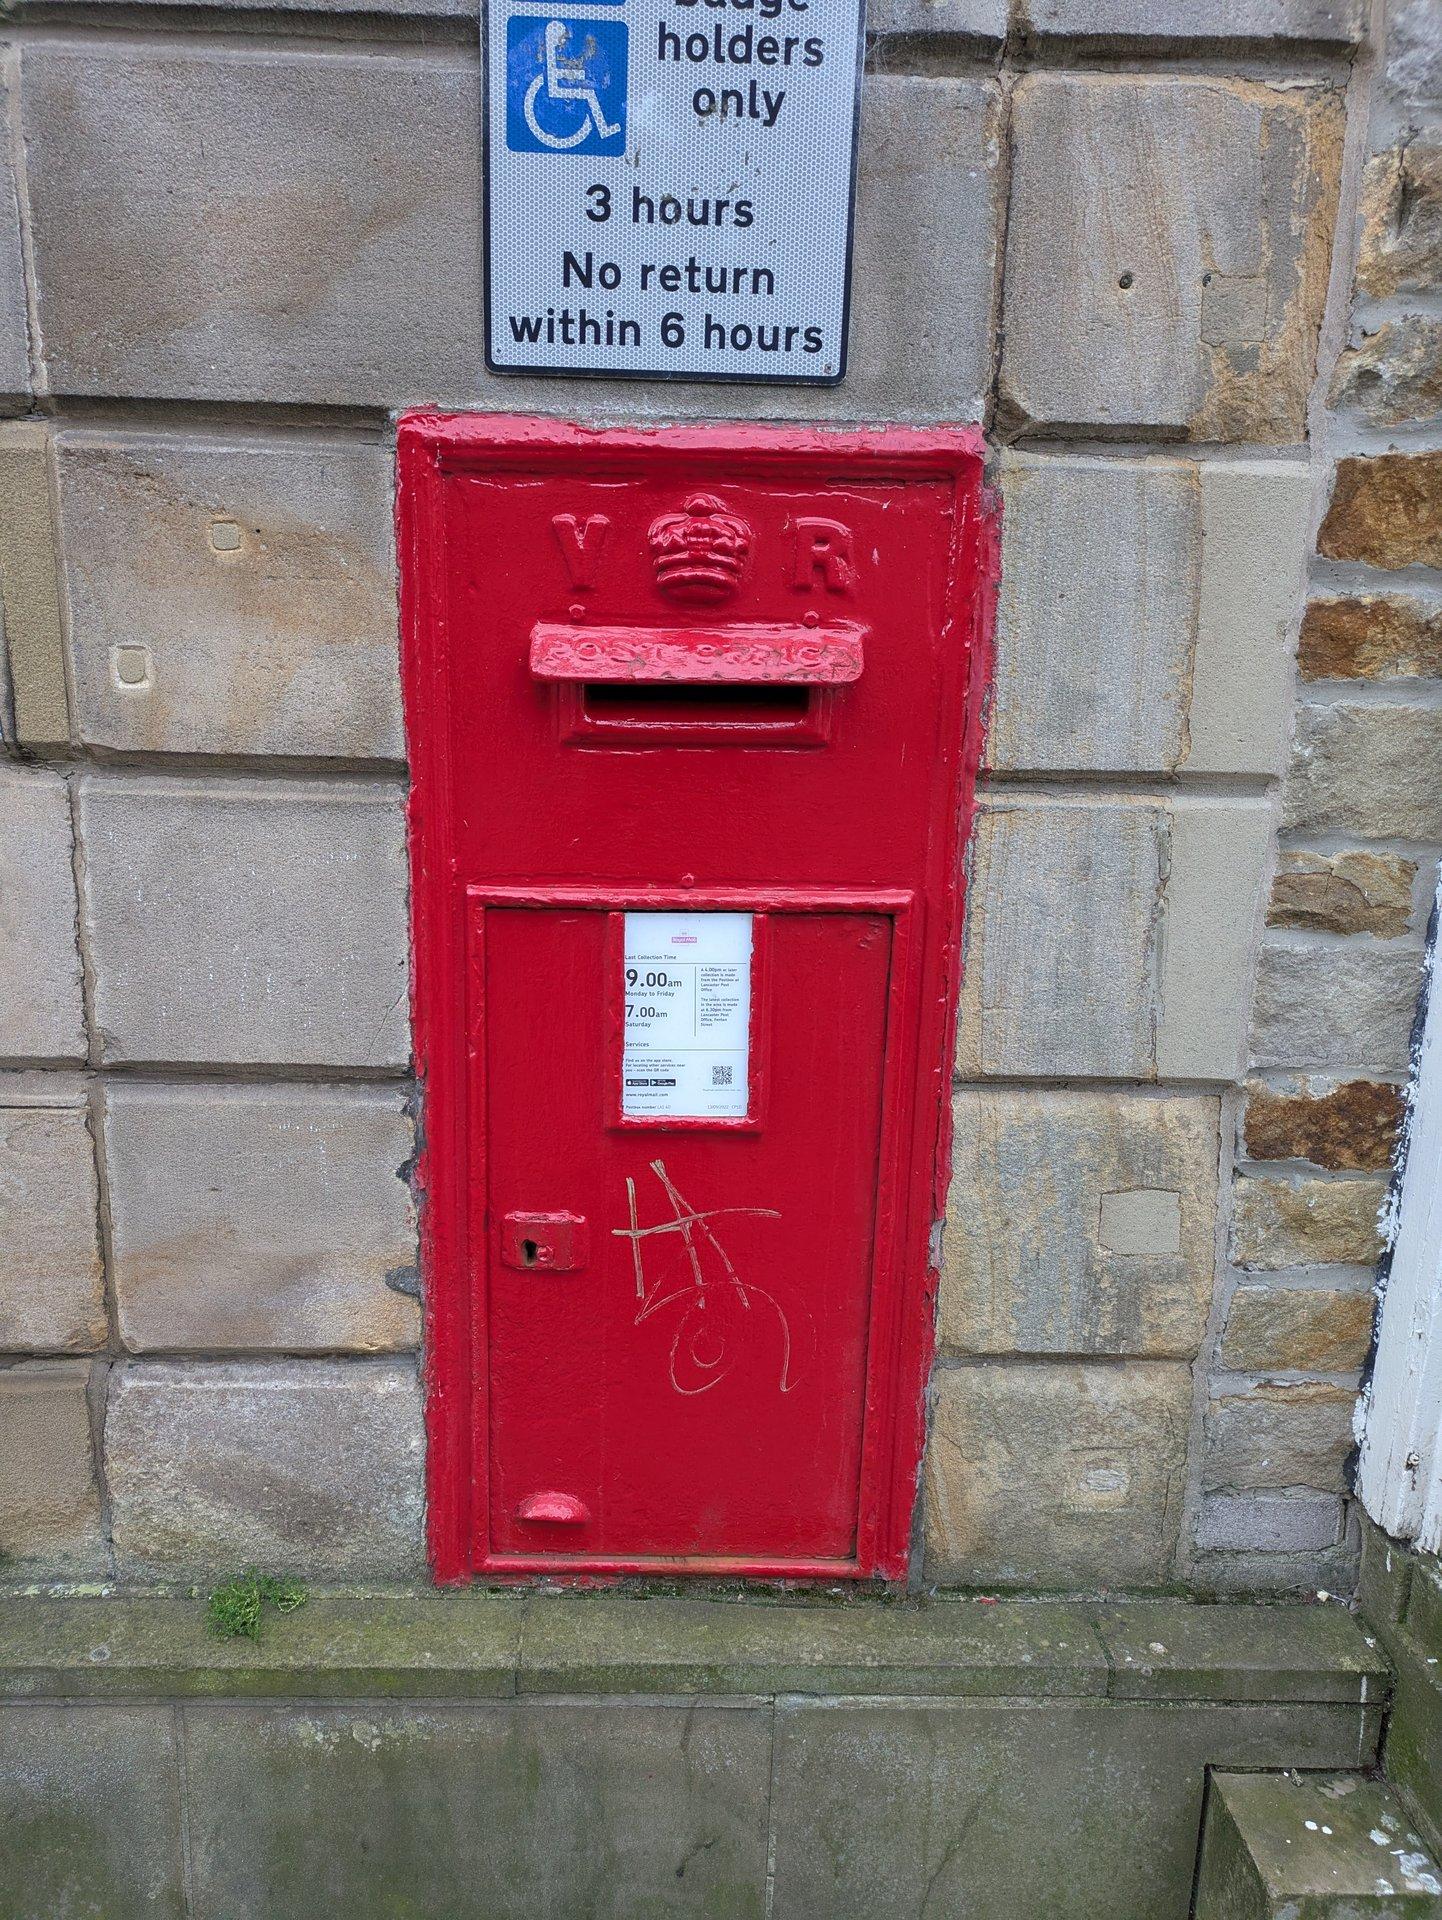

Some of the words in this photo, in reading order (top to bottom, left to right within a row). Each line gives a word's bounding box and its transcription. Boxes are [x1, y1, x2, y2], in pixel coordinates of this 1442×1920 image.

[658, 22, 824, 66] holders
[692, 80, 786, 127] only
[586, 185, 611, 222] 3
[632, 187, 754, 227] hours
[563, 252, 622, 290] No
[641, 257, 774, 294] return
[509, 308, 641, 346] within
[660, 312, 685, 348] 6
[704, 314, 823, 353] hours
[626, 969, 682, 987] 9.00am
[625, 1005, 667, 1017] 7.00am
